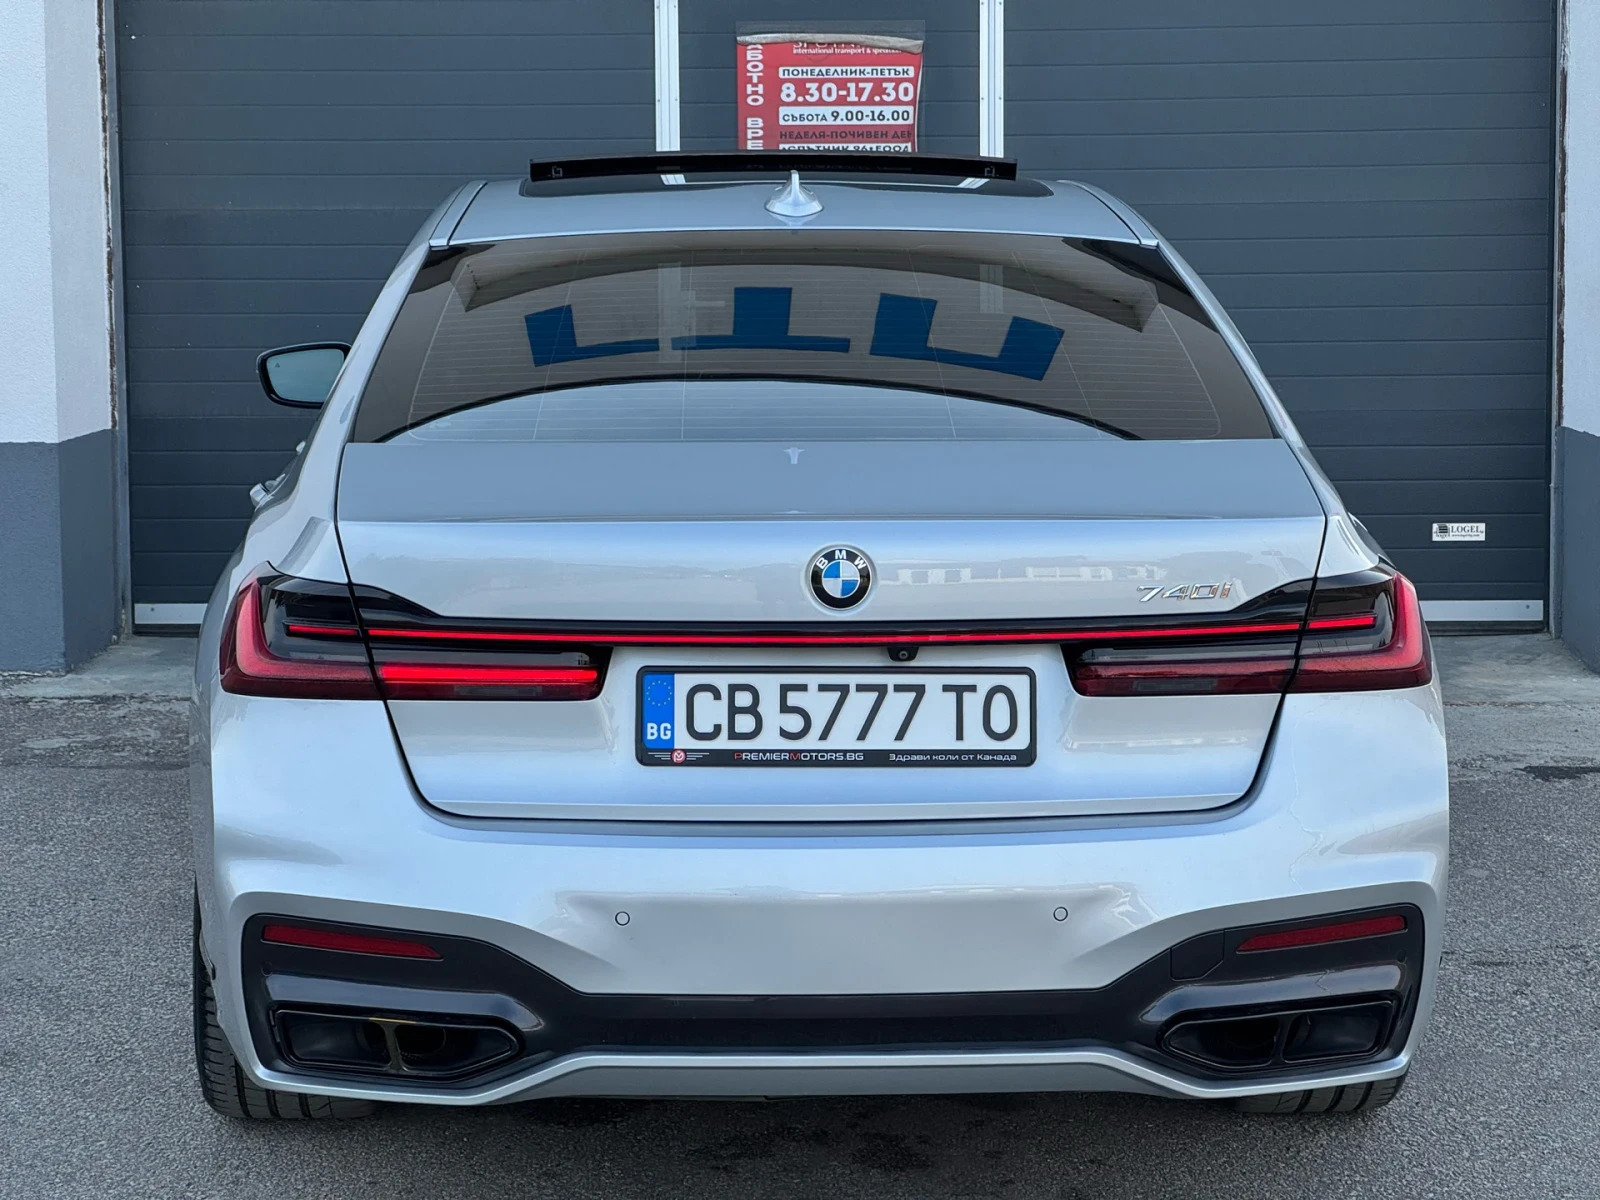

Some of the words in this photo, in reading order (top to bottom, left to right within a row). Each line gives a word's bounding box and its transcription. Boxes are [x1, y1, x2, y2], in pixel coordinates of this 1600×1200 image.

[835, 47, 865, 55] transport
[782, 68, 910, 78] ПОНЕДЕЛНИК-ПЕТЪК
[780, 82, 914, 102] 8.30-17.30
[782, 113, 828, 122] СЪБОТА
[831, 110, 910, 122] 9.00-16.00
[779, 130, 889, 140] НЕДЕЛЯ-ПОЧИВЕН
[1451, 525, 1479, 533] LOGEL
[816, 550, 867, 569] BMW
[1137, 582, 1232, 602] 740i
[686, 683, 763, 741] CB
[779, 683, 926, 741] 5777
[646, 722, 672, 740] BG
[734, 752, 864, 761] PREMIERMOTORS.BG
[889, 753, 931, 761] Здрави
[976, 753, 1017, 761] Канада
